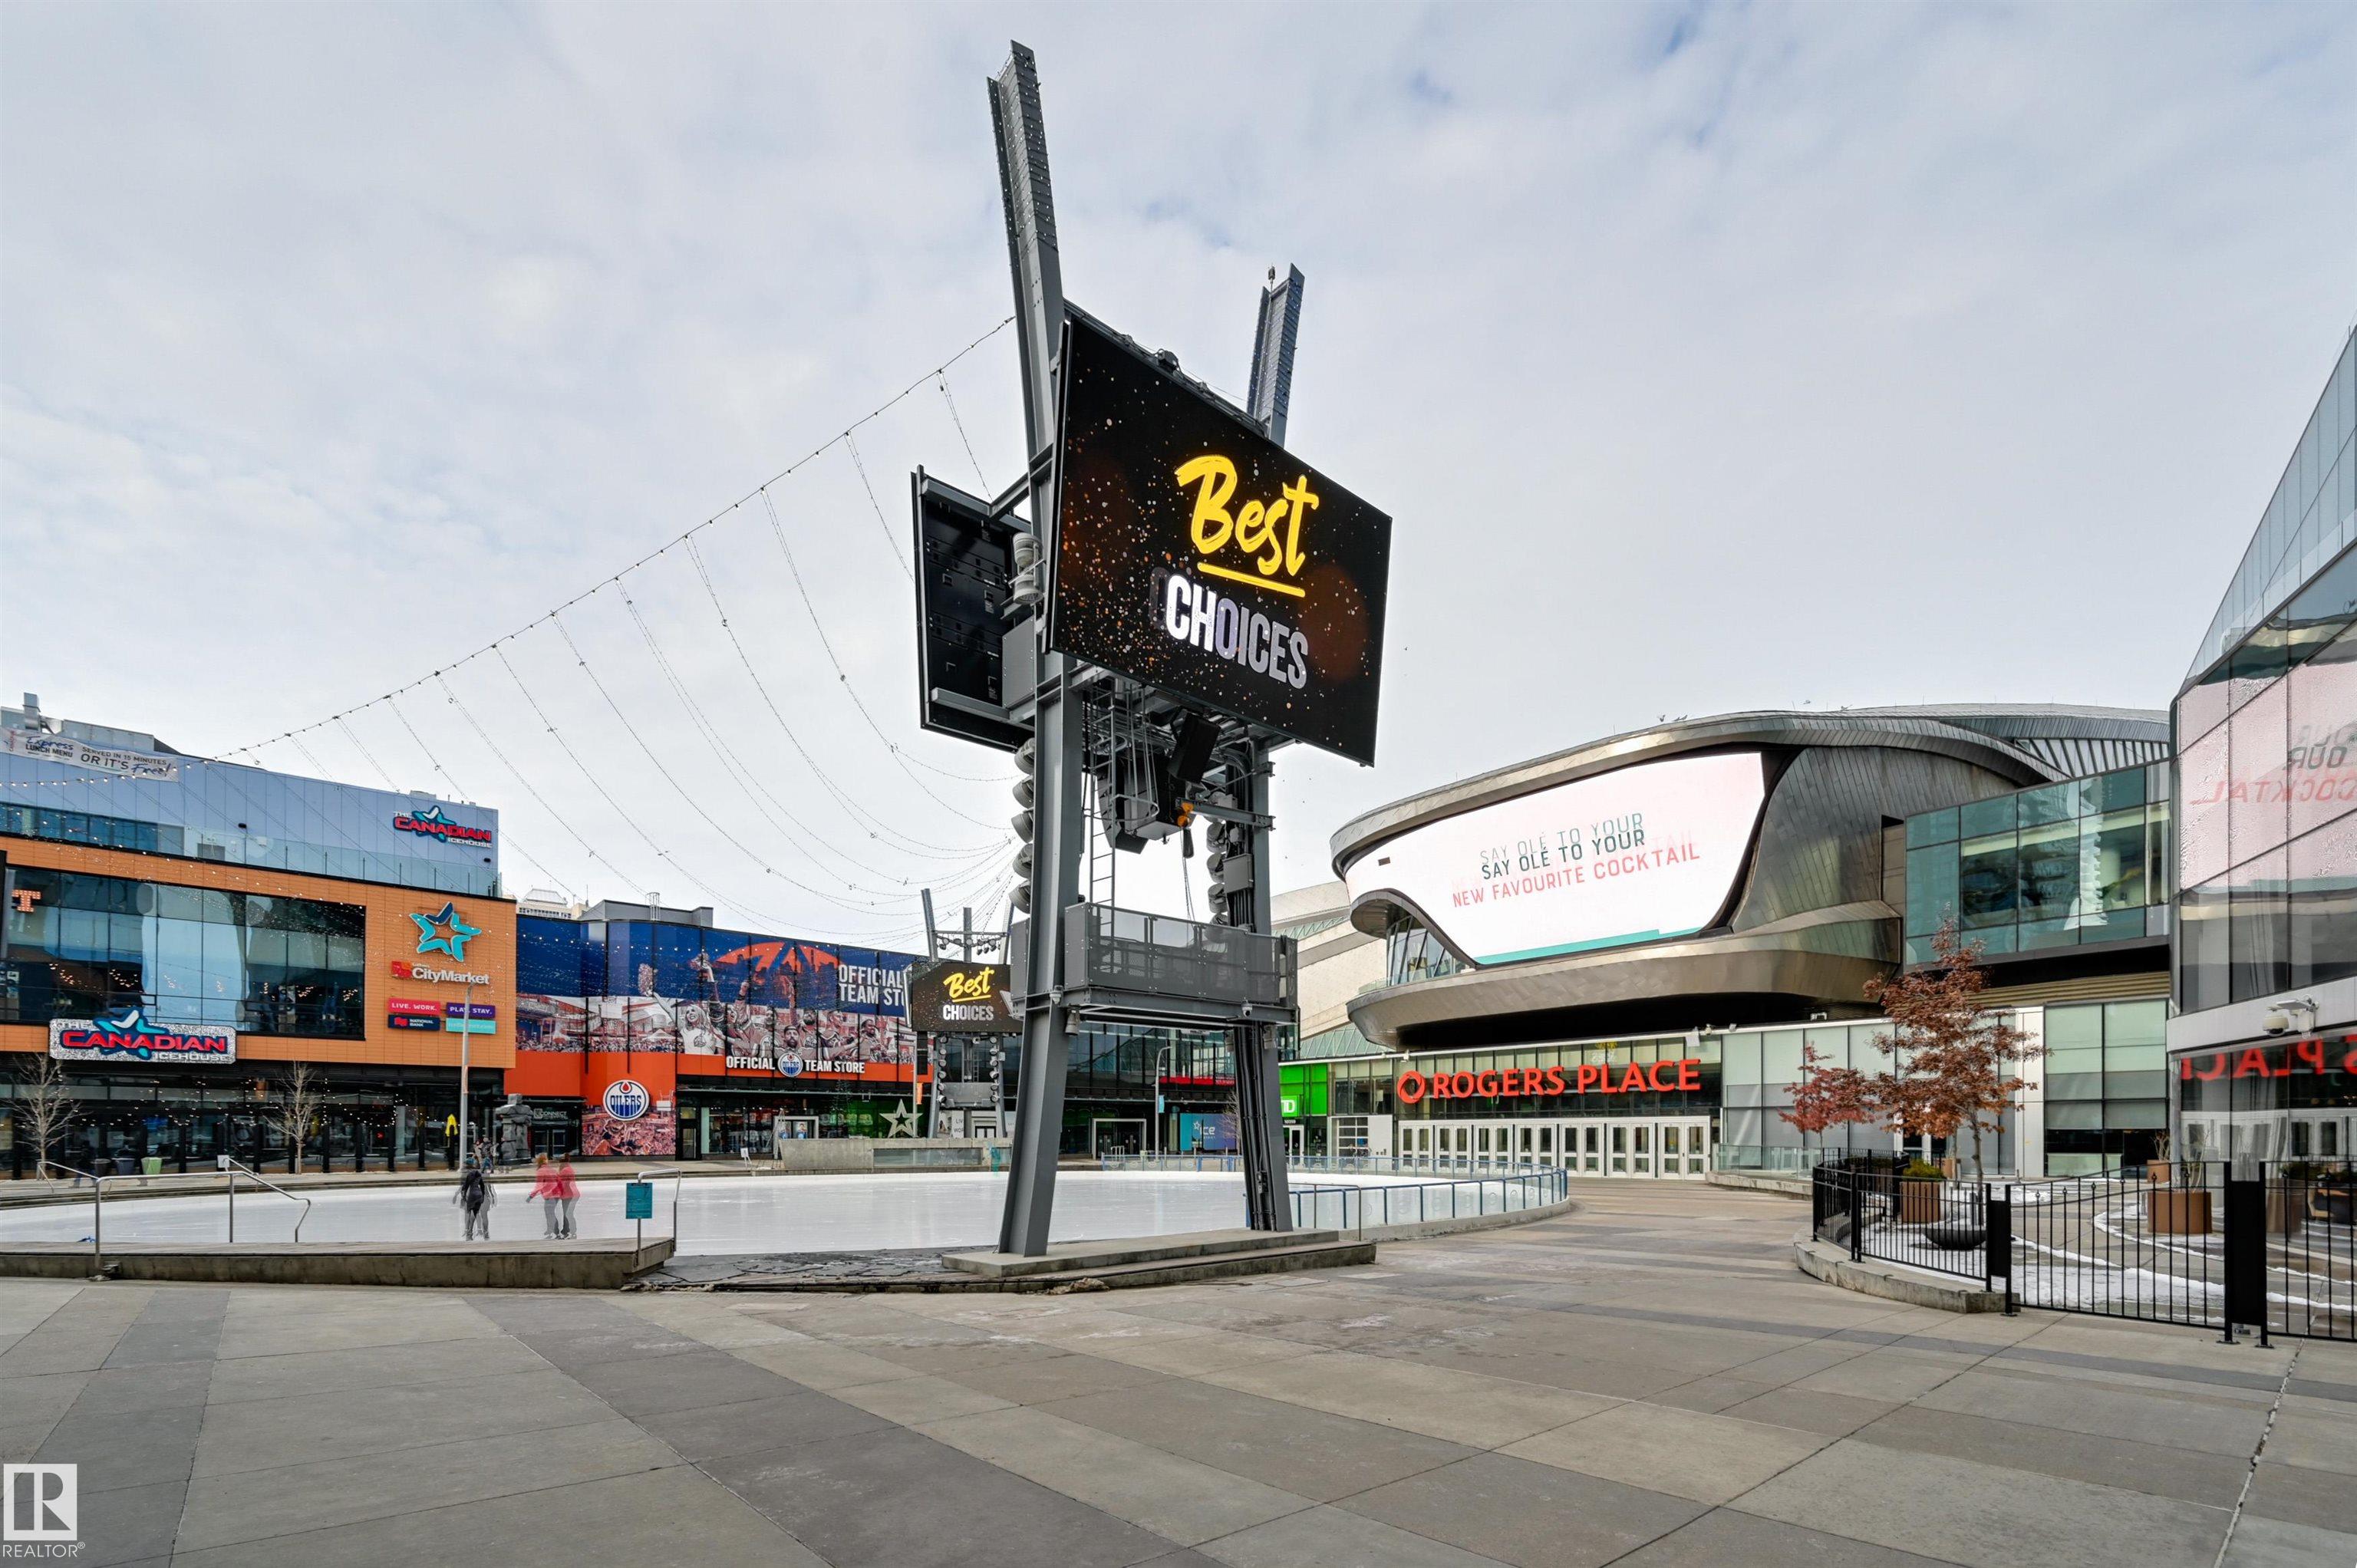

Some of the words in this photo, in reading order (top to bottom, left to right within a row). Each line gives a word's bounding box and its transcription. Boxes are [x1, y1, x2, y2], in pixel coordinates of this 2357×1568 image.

[1175, 455, 1319, 576] Best
[1165, 575, 1308, 689] CHOICES
[25, 743, 50, 753] LUNCH
[52, 748, 73, 757] MENU
[26, 736, 74, 750] Express
[81, 753, 100, 765] OR
[104, 758, 129, 770] IT'S
[131, 762, 171, 777] Free!
[82, 746, 111, 758] SERVED
[134, 756, 167, 766] MINUTES
[394, 817, 492, 842] CANADIAN
[448, 837, 493, 848] ICEHOUSE
[1482, 859, 1510, 881] SAY
[1519, 847, 1551, 872] OLÉ
[1558, 843, 1583, 863] TO
[1592, 828, 1645, 856] YOUR
[1452, 888, 1484, 908] NEW
[1492, 866, 1585, 901] FAVOURITE
[1594, 843, 1701, 881] COCKTAIL
[412, 967, 490, 985] CityMarket
[839, 964, 902, 987] OFFICIAL
[943, 966, 995, 999] Best
[839, 983, 879, 1005] TEAM
[943, 1004, 994, 1022] CHOICES
[62, 1031, 226, 1052] CANADIAN
[155, 1053, 229, 1062] ICEHOUSE
[726, 1056, 775, 1070] OFFICIAL
[805, 1059, 832, 1072] TEAM
[833, 1061, 865, 1073] STORE
[1433, 1066, 1566, 1099] ROGERS
[1577, 1059, 1701, 1094] PLACE
[610, 1095, 641, 1109] OILERS
